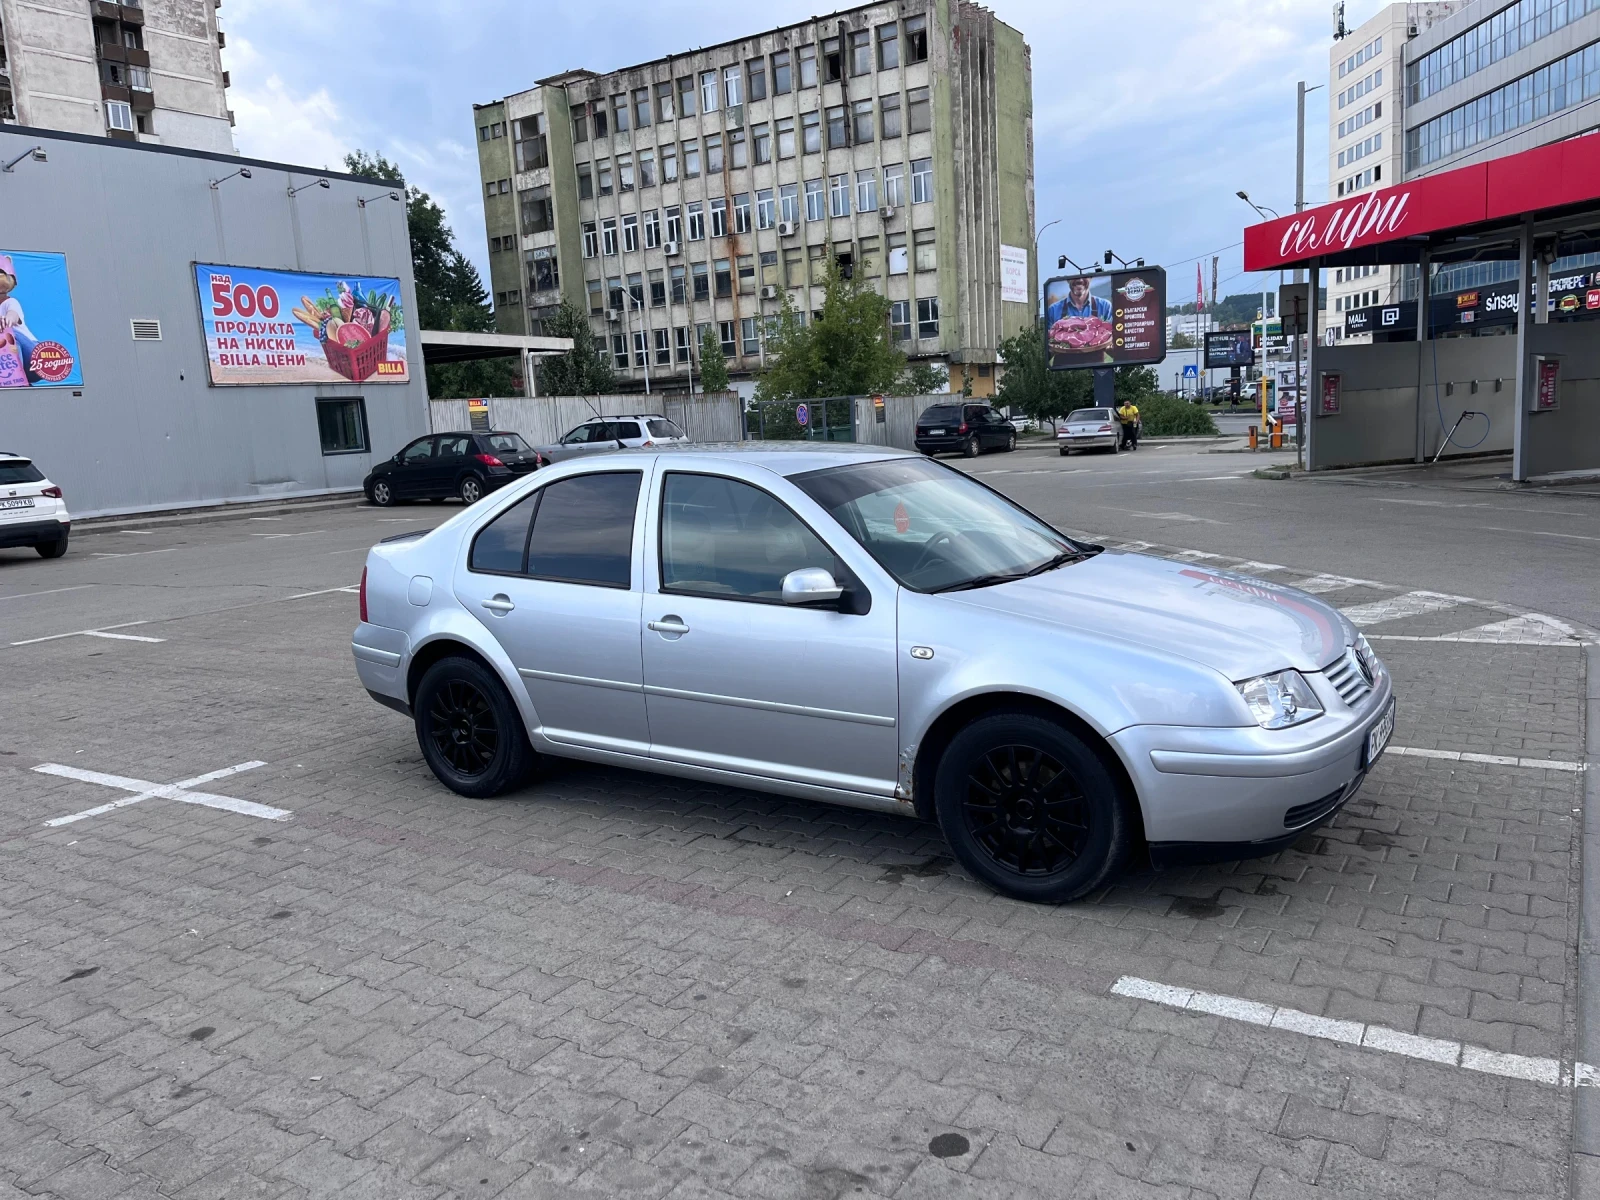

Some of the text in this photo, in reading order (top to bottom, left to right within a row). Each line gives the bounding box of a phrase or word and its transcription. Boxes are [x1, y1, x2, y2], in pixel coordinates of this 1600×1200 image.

[1280, 191, 1410, 257] селфи
[211, 274, 231, 285] над
[212, 283, 280, 318] 500
[1486, 292, 1519, 313] sinsay
[1348, 313, 1367, 325] MALL
[215, 321, 295, 336] ПРОДУКТА
[217, 337, 295, 350] НА НИСКИ
[40, 351, 60, 359] BILLA
[220, 354, 306, 368] BILLA ЦЕНИ
[29, 359, 43, 371] 25
[378, 362, 403, 374] BILLA
